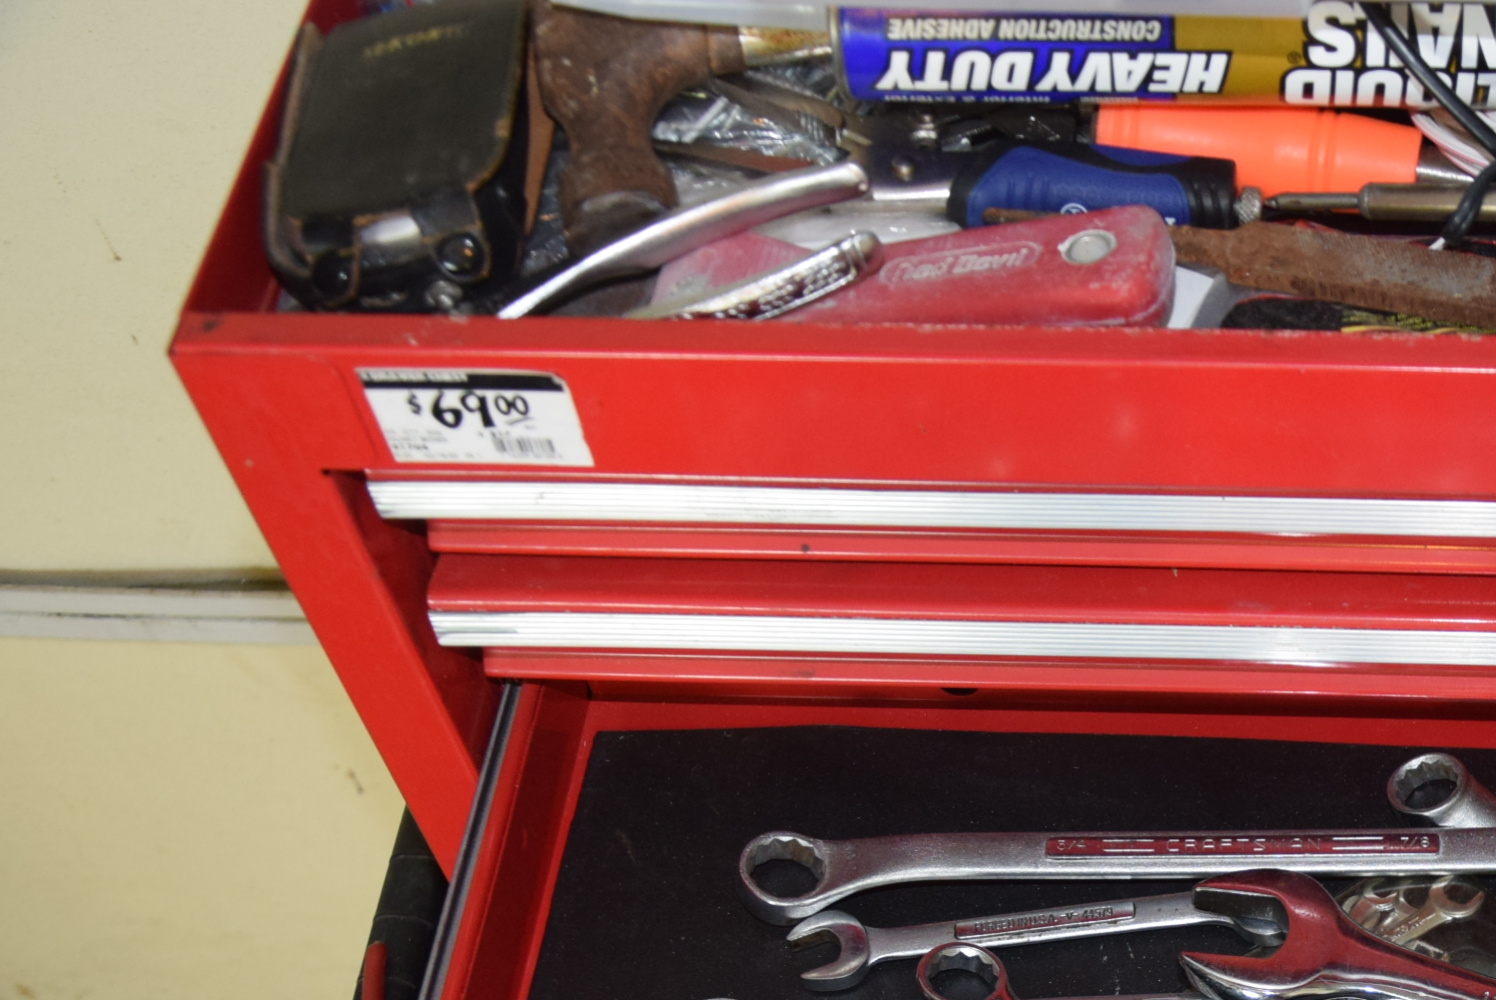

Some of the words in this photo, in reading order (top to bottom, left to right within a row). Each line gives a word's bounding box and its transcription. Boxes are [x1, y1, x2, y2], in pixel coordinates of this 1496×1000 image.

[888, 18, 994, 40] ADHESIVE
[1000, 19, 1161, 41] CONSTRUCTION
[876, 50, 1034, 91] DUTY
[1034, 51, 1232, 93] HEAVY
[952, 248, 1029, 275] Devil
[1165, 837, 1322, 853] CRAFTSMAN
[1399, 836, 1431, 849] 7/8
